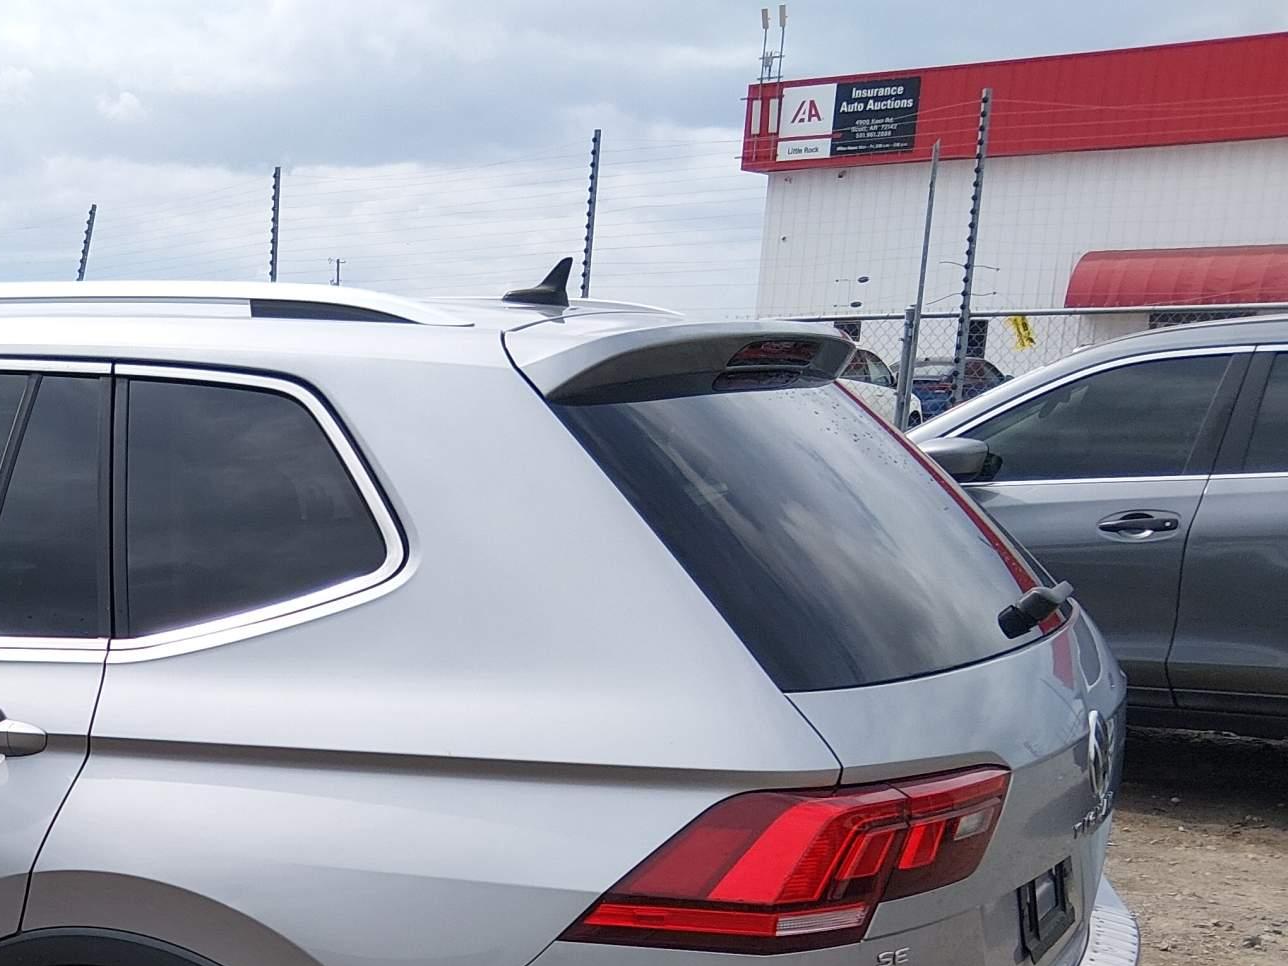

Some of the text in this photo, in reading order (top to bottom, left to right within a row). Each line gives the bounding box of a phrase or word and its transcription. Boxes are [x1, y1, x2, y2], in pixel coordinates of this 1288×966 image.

[852, 86, 904, 99] Insurance
[840, 98, 914, 113] Auto Auctions
[787, 146, 819, 155] Little Rock
